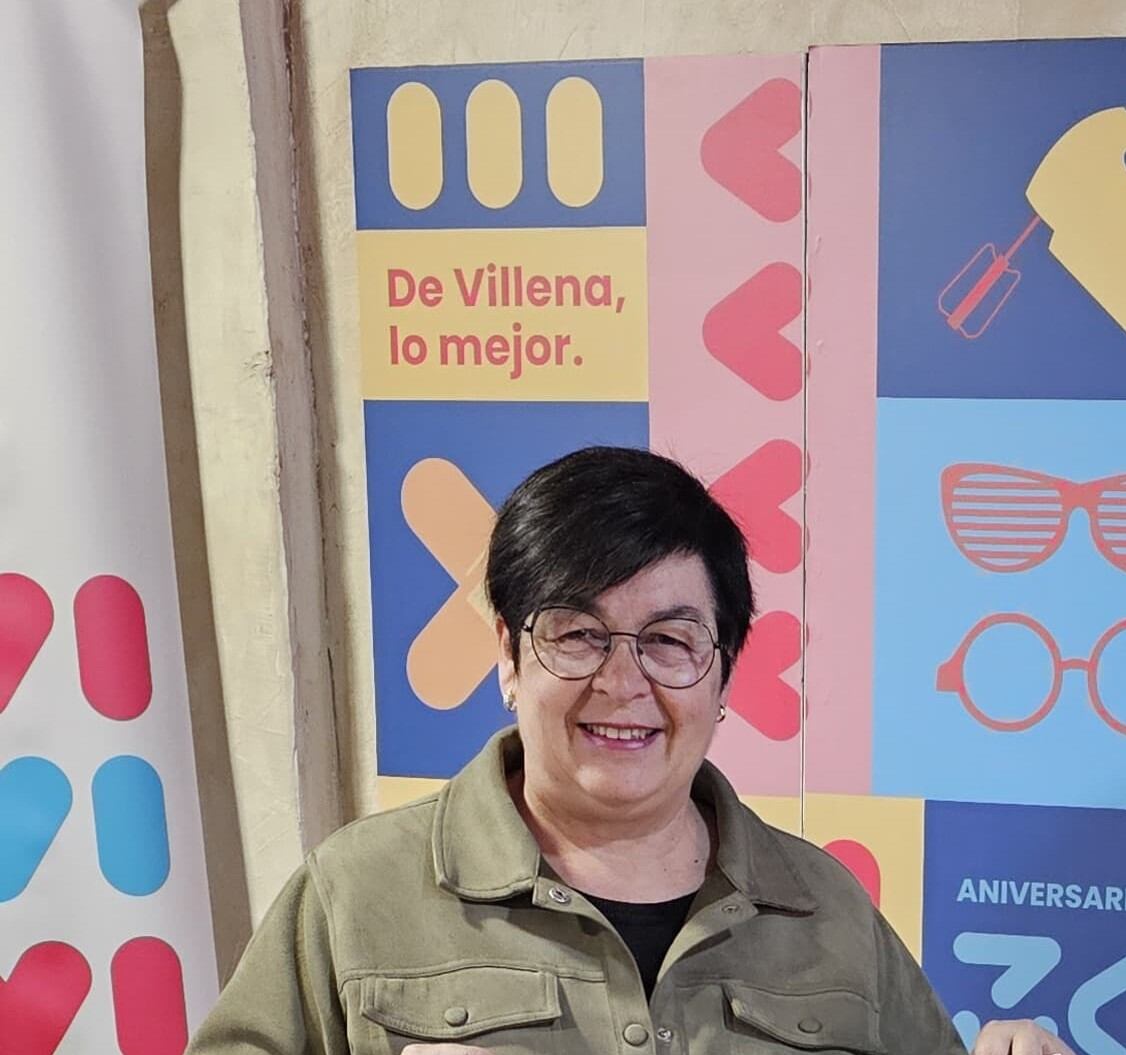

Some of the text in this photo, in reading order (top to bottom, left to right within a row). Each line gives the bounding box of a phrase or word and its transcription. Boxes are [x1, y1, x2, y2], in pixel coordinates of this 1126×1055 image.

[387, 263, 626, 314] De Villena,
[389, 323, 583, 379] lo mejor.
